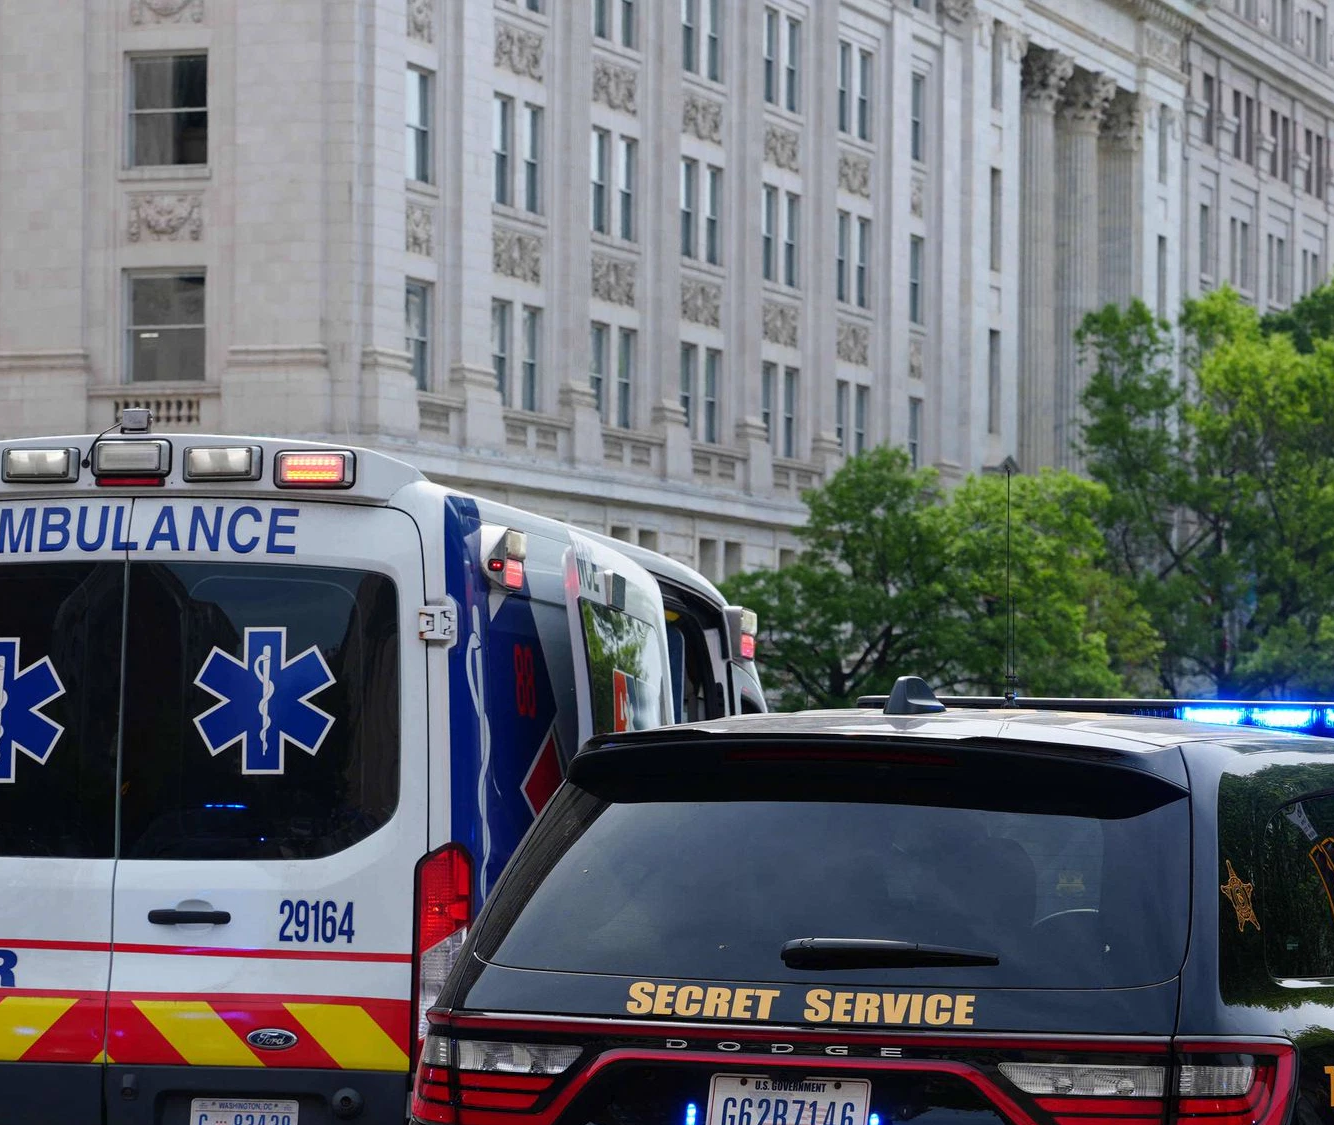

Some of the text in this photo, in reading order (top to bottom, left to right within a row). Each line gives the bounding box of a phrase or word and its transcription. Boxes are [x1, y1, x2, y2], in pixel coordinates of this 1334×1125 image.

[279, 900, 355, 944] 29164
[626, 981, 976, 1026] SECRET SERVICE
[666, 1039, 903, 1058] DODGE
[755, 1080, 827, 1093] U.S. GOVERNMENT
